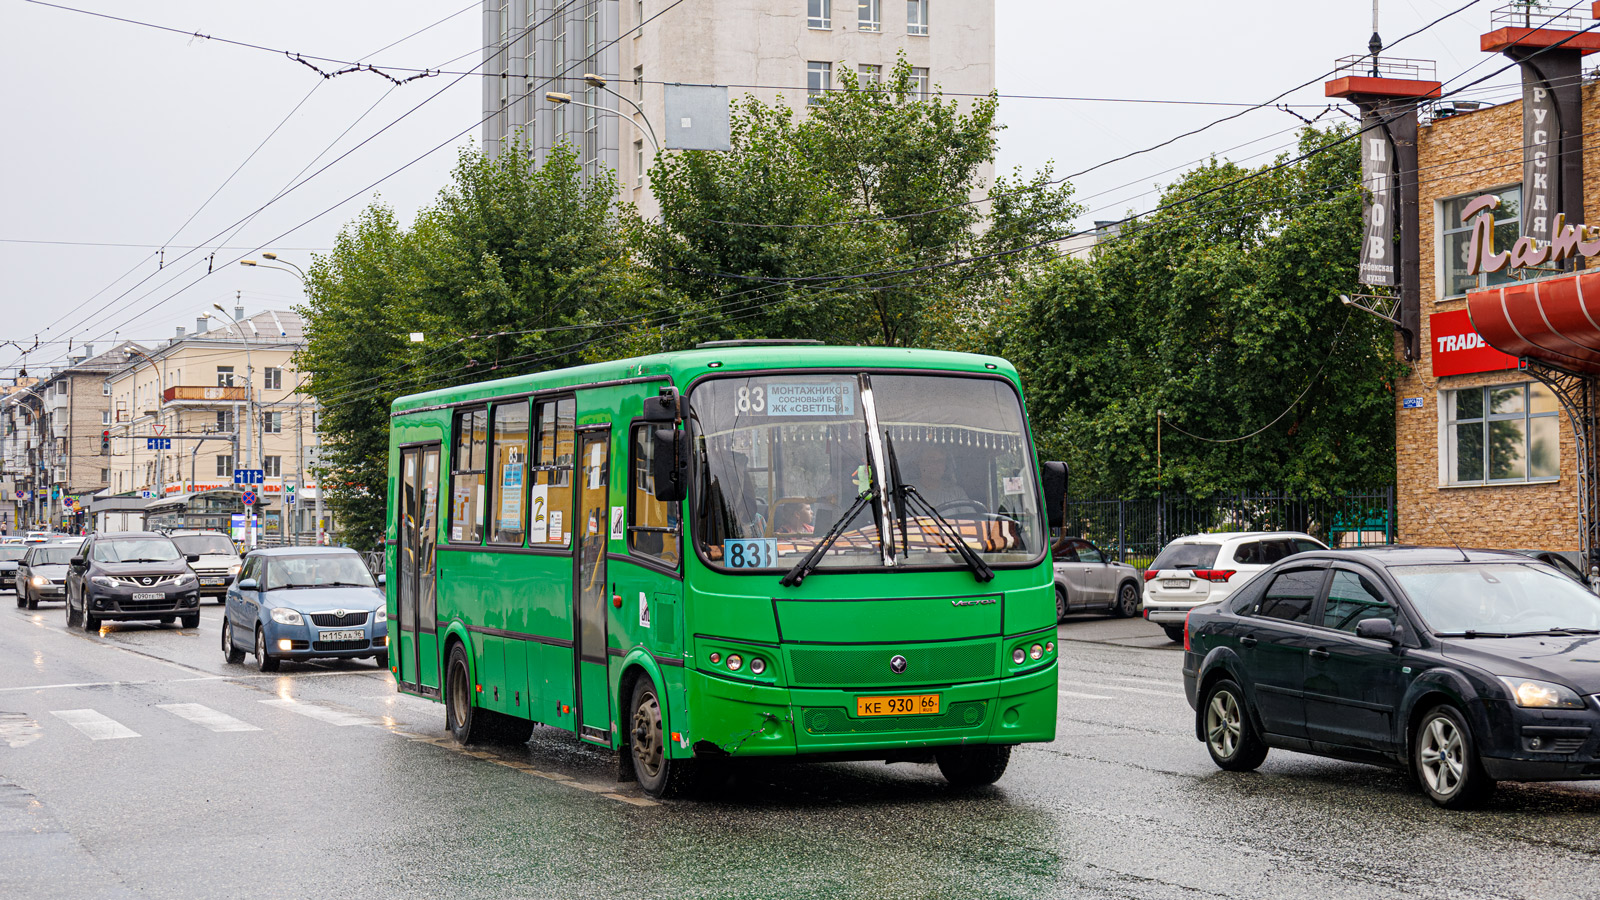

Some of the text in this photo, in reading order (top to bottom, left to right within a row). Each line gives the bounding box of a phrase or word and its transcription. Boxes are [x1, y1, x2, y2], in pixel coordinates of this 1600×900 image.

[1533, 87, 1547, 233] РУССКАЯ
[1369, 138, 1387, 260] ПЛОВ
[738, 386, 765, 412] 83
[771, 386, 850, 395] МОНТАЖНИКОВ
[778, 395, 825, 403] СОСНОВЫЙ
[772, 404, 788, 413] ЖК
[508, 446, 518, 464] 83
[731, 543, 761, 568] 83
[951, 599, 996, 607] VECTOR
[865, 696, 935, 713] КЕ 930 66
